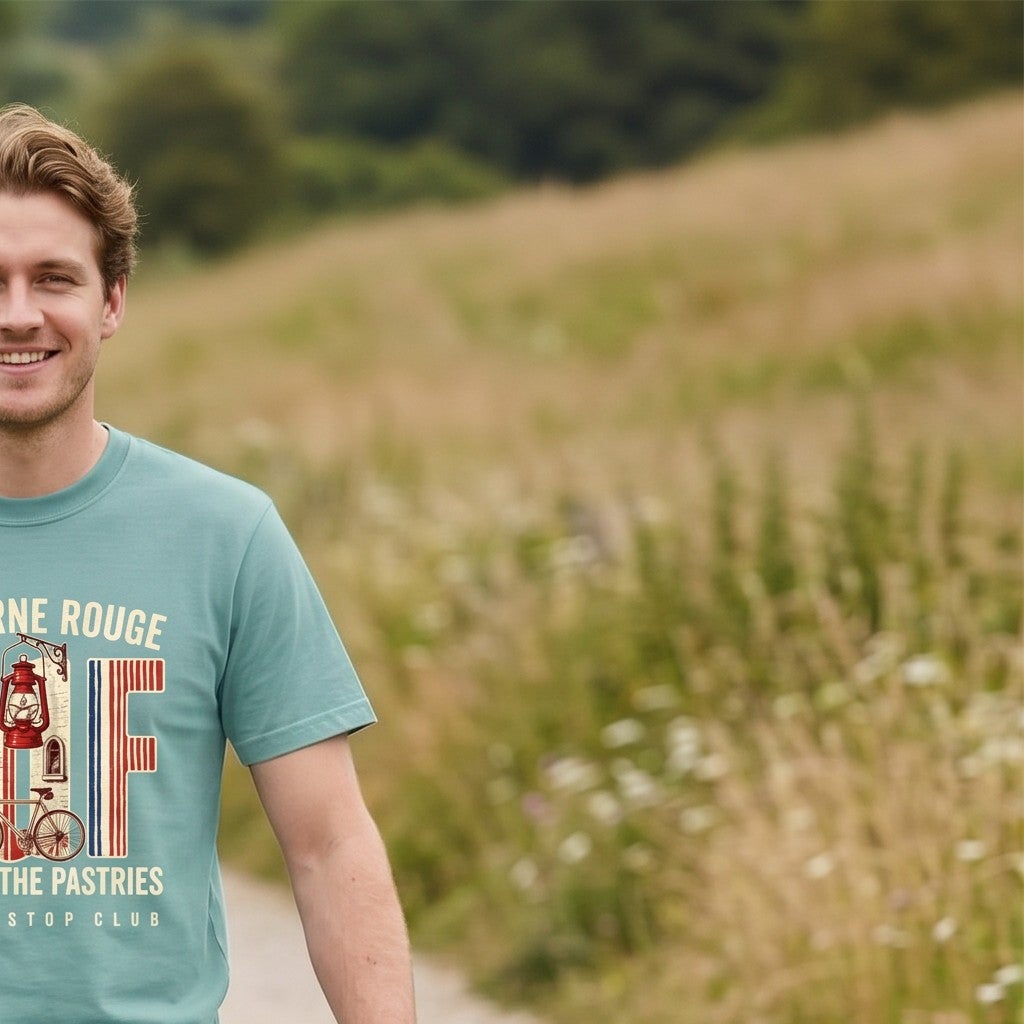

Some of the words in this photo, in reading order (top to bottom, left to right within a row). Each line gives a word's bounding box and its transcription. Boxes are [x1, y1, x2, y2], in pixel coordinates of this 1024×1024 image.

[60, 599, 167, 651] ROUGE
[52, 867, 163, 895] PASTRIES
[8, 912, 73, 926] STOP
[94, 912, 159, 926] CLUB
